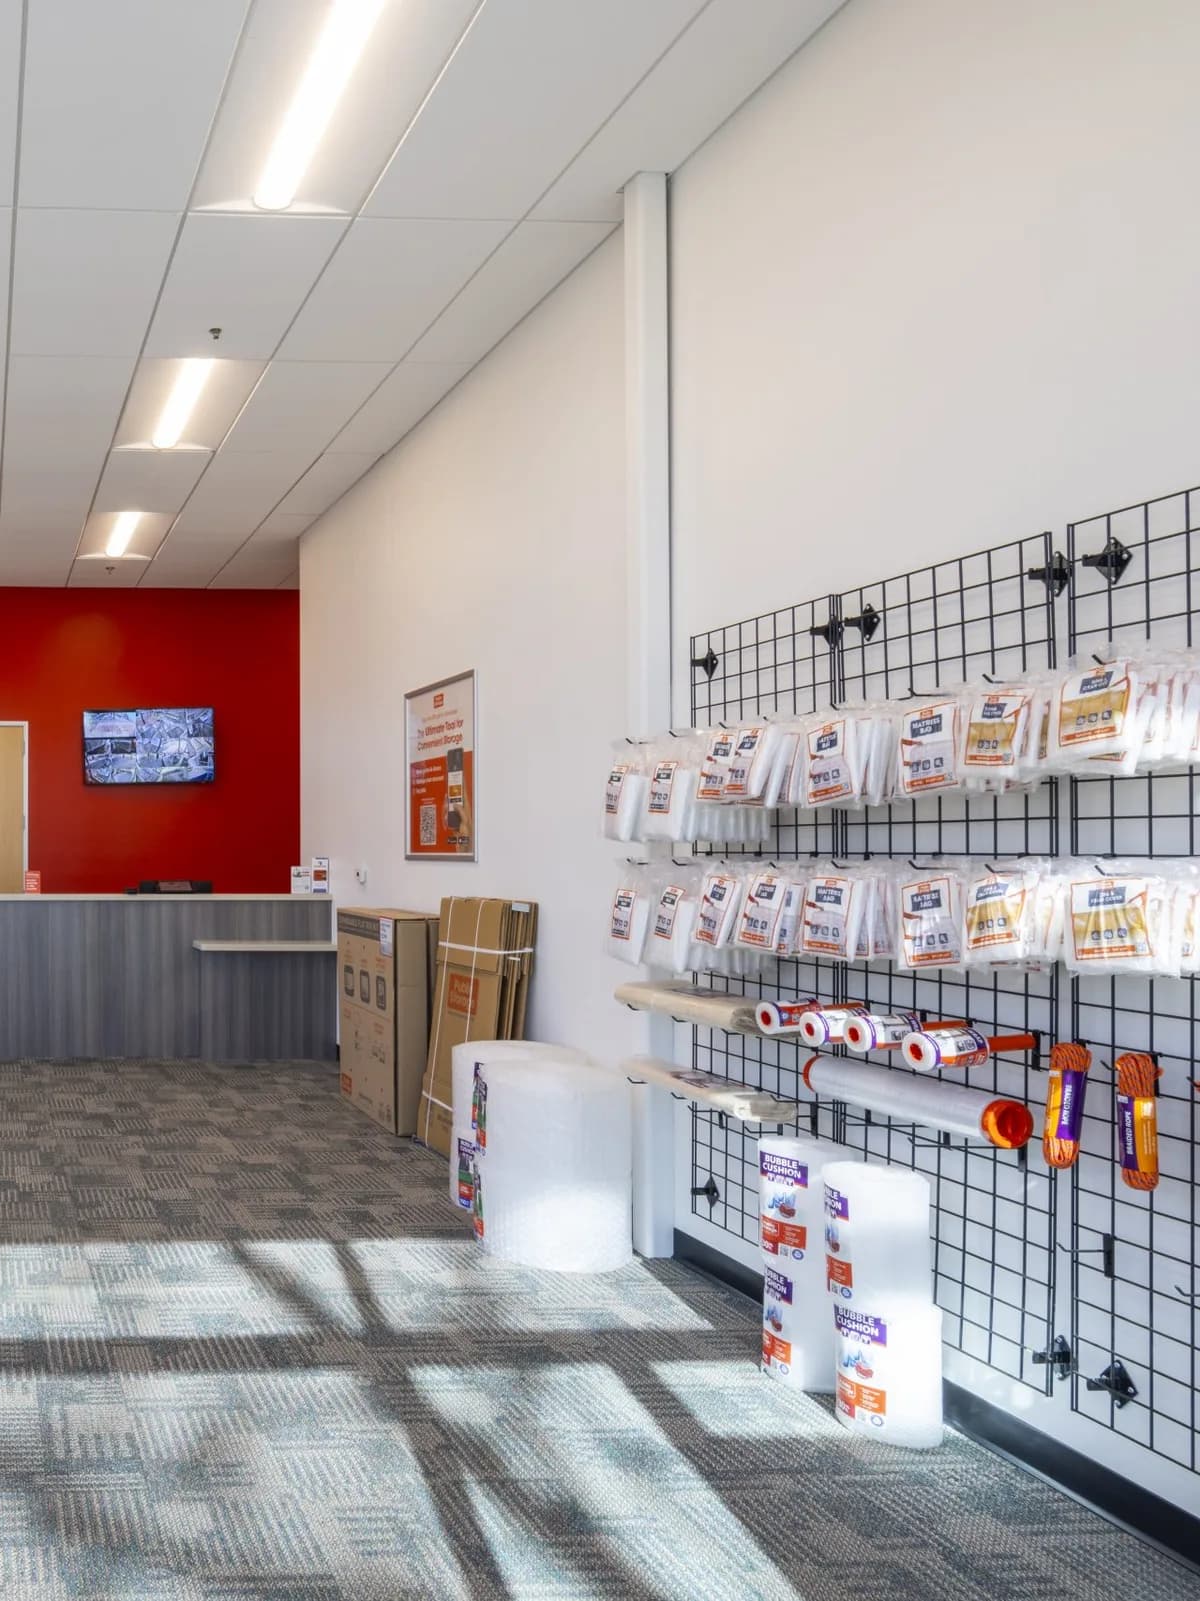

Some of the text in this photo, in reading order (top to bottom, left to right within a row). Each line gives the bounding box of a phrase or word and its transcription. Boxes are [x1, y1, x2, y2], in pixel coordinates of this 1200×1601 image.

[762, 1162, 801, 1179] CUSHION
[764, 1153, 799, 1170] BUBBLE
[766, 1277, 787, 1296] SHION
[837, 1304, 875, 1328] BUBBLE
[836, 1315, 880, 1338] CUSHION
